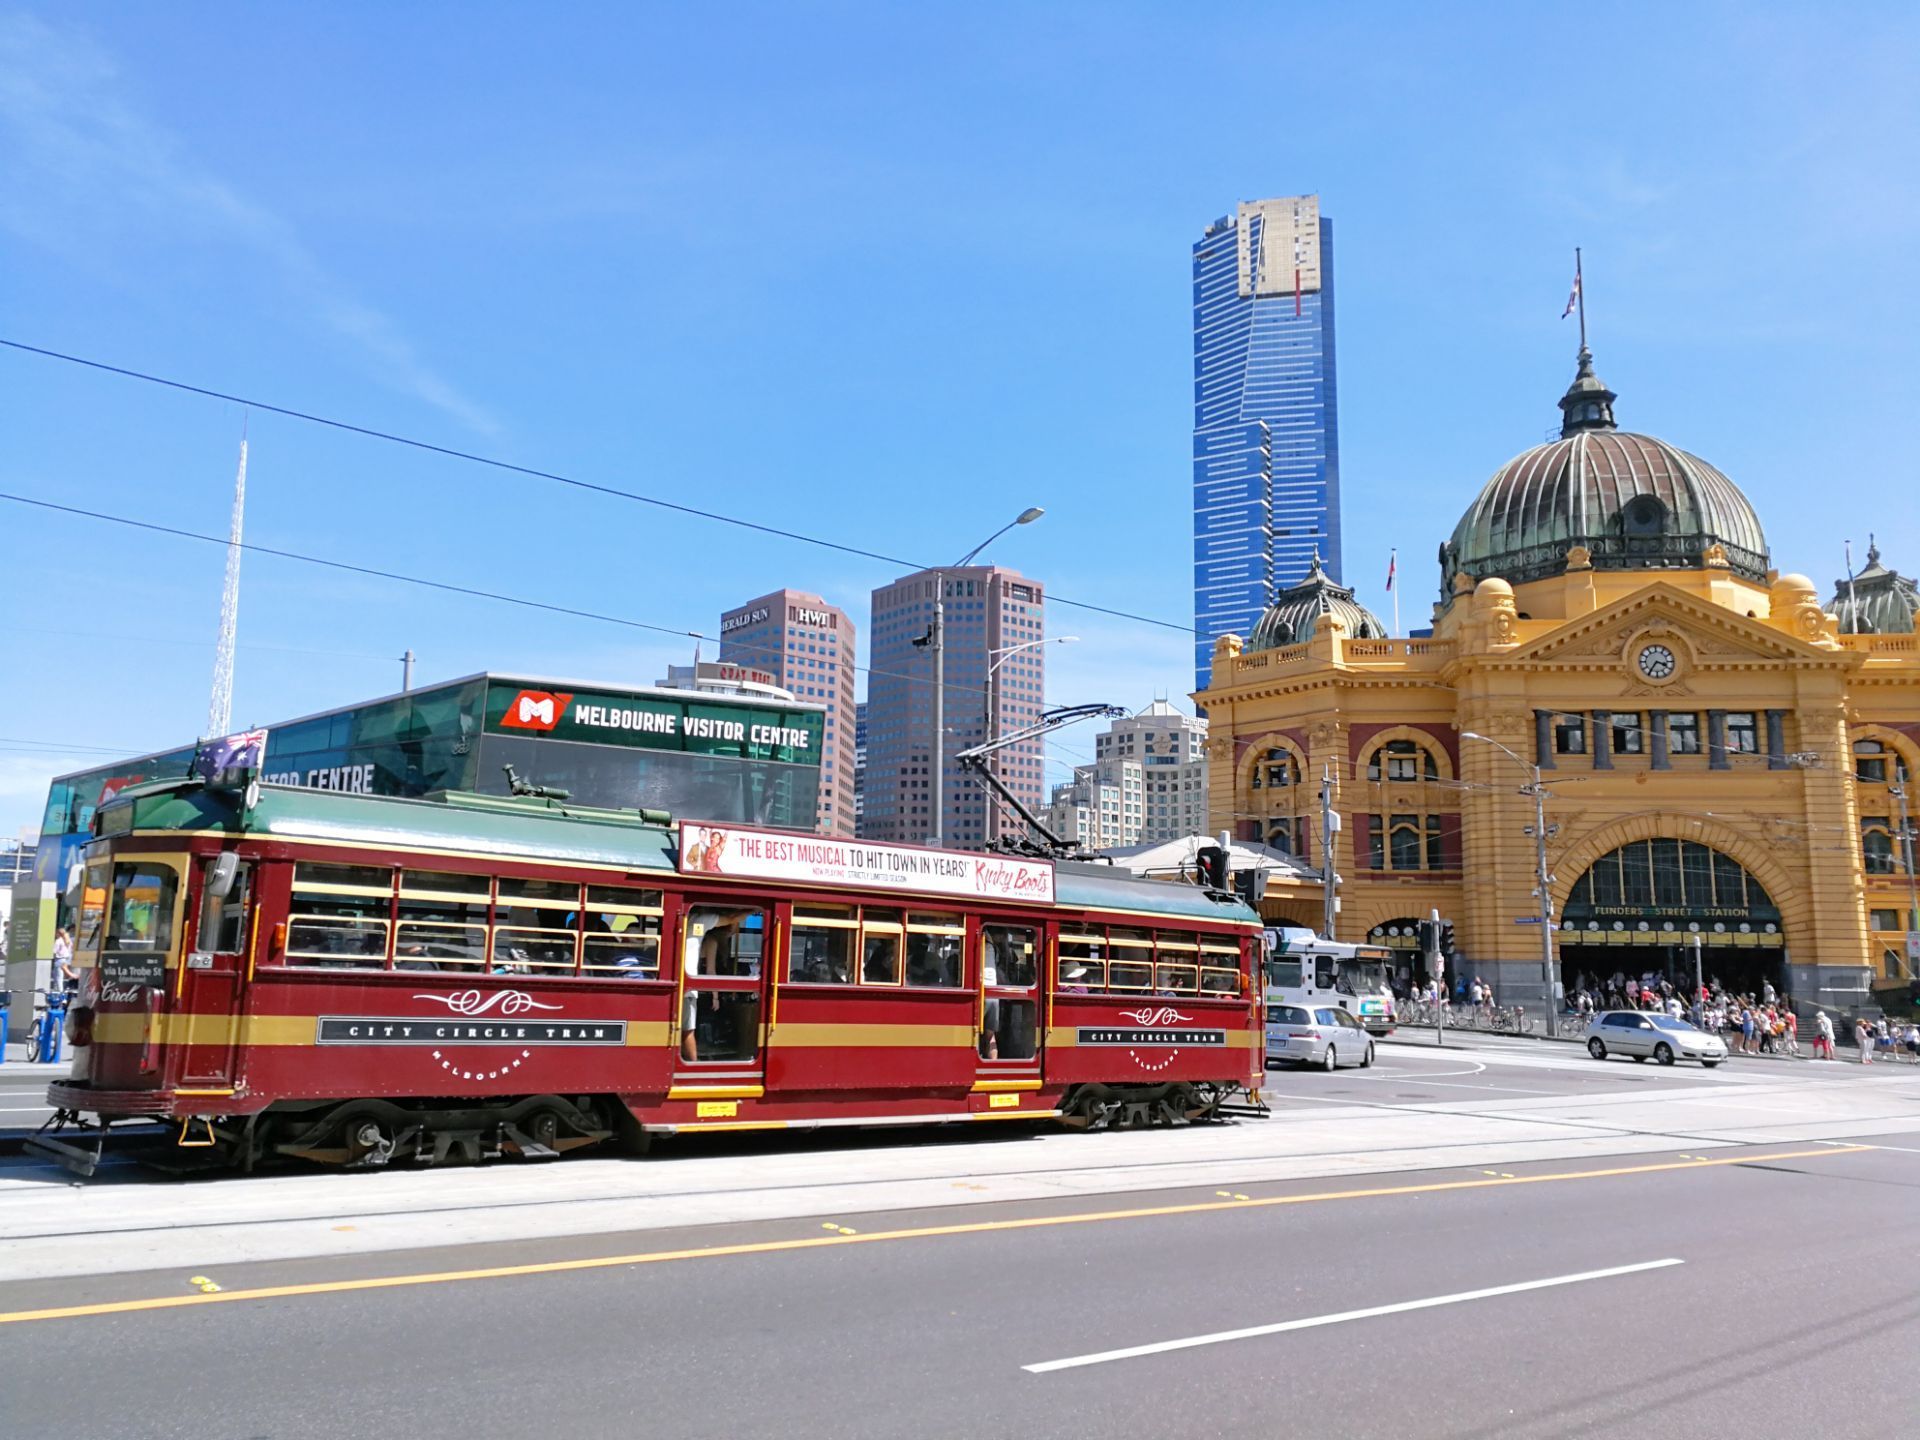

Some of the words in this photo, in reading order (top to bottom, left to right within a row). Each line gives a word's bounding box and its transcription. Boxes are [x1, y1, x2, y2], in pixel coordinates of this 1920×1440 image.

[752, 608, 768, 622] SUN
[800, 609, 829, 625] HWT
[720, 667, 746, 680] QUAY
[751, 671, 770, 684] WEST
[574, 704, 676, 734] MELBOURNE
[683, 716, 744, 742] VISITOR
[751, 724, 809, 748] CENTRE
[307, 764, 375, 793] CENTRE
[766, 841, 794, 861] BEST
[798, 844, 847, 867] MUSICAL
[850, 849, 863, 868] TO
[867, 851, 883, 870] HIT
[887, 853, 917, 873] TOWN
[920, 857, 930, 874] IN
[975, 860, 1013, 893] Kinky
[1014, 868, 1050, 893] Boots
[1595, 906, 1644, 916] FLINDERS
[1655, 907, 1693, 917] STREET
[1703, 908, 1749, 918] STATION
[104, 966, 117, 976] via
[117, 966, 128, 976] La
[129, 966, 151, 977] Trobe
[153, 966, 162, 977] St
[101, 980, 141, 1002] Circle
[349, 1026, 413, 1038] CITY
[436, 1027, 526, 1039] CIRCLE
[546, 1028, 605, 1039] TRAM
[1091, 1033, 1122, 1041] CITY
[1132, 1034, 1177, 1042] CIRCLE
[1186, 1034, 1216, 1042] TRAM
[432, 1049, 531, 1080] MELBOURNE
